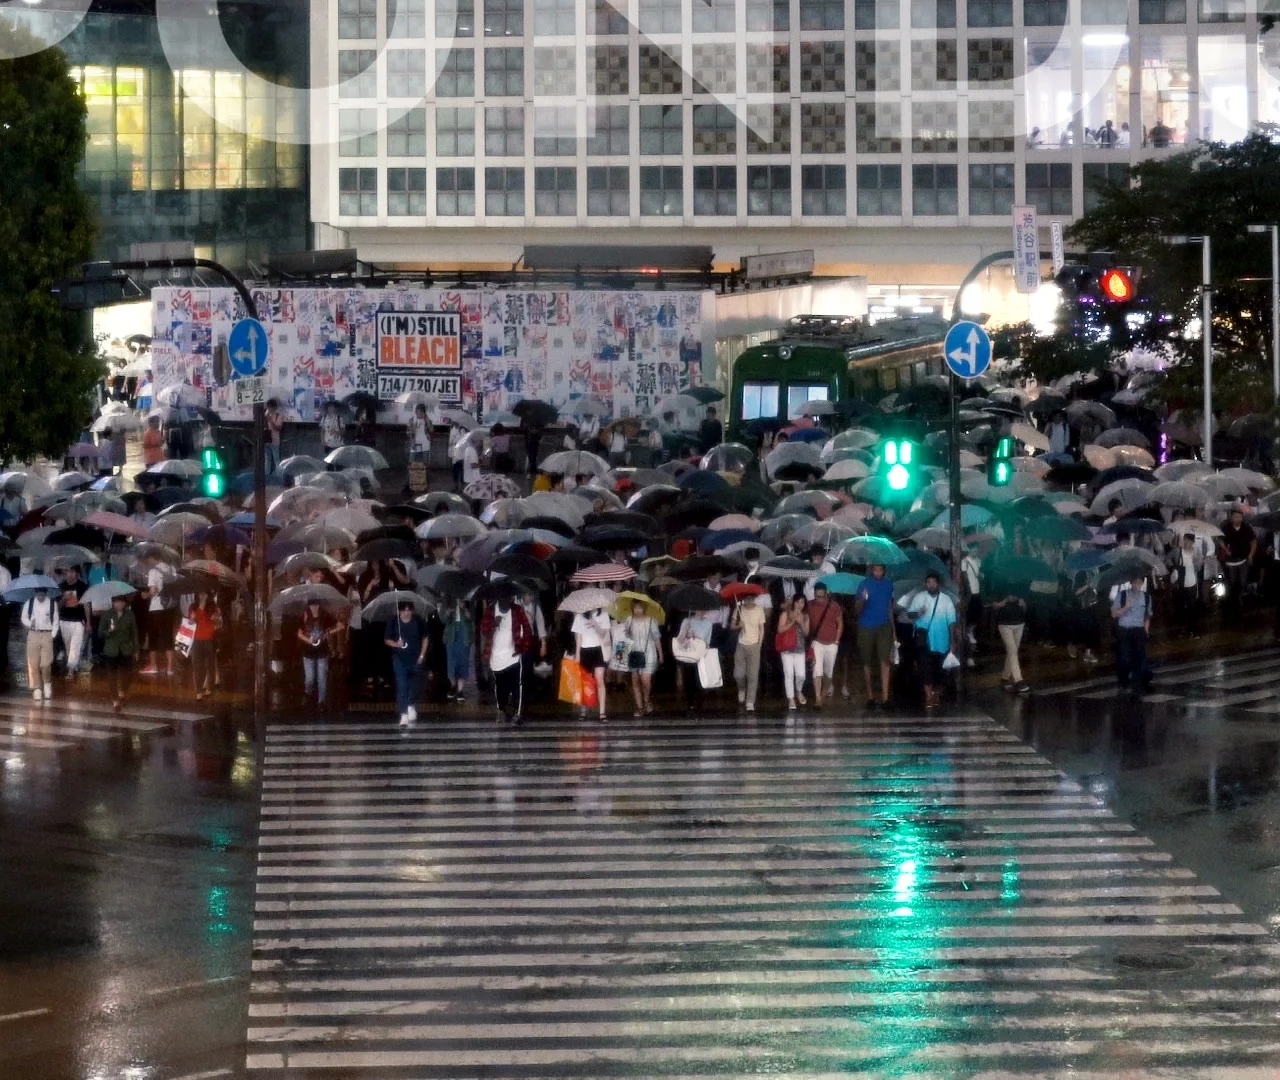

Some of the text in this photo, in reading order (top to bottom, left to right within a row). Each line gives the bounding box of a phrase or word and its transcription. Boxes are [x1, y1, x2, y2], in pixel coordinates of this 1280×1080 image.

[1023, 212, 1038, 287] 渋谷駅前
[381, 315, 458, 337] (I'M) STILL
[380, 336, 458, 366] BLEACH
